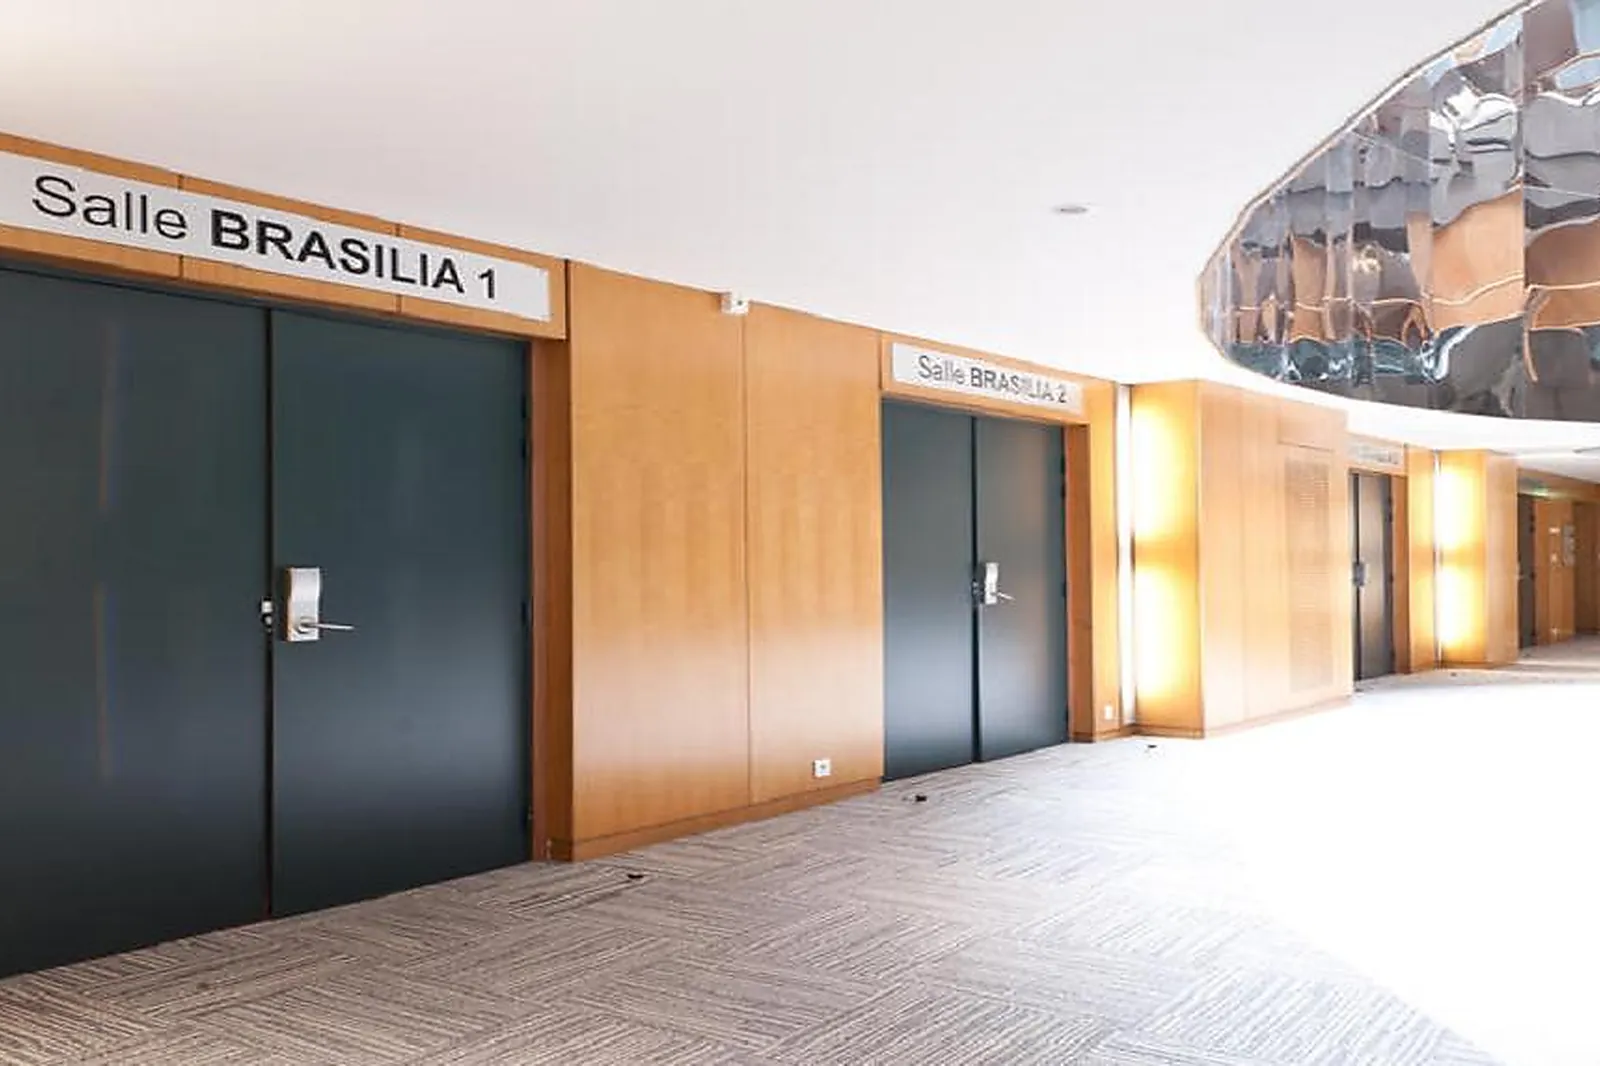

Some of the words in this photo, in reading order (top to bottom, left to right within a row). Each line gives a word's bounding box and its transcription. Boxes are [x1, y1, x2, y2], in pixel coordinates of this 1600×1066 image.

[32, 175, 187, 240] Salle
[210, 209, 465, 294] BRASILIA
[479, 269, 496, 299] 1
[918, 354, 965, 385] Salle
[970, 366, 1054, 402] BRASILIA
[1056, 384, 1067, 403] 2
